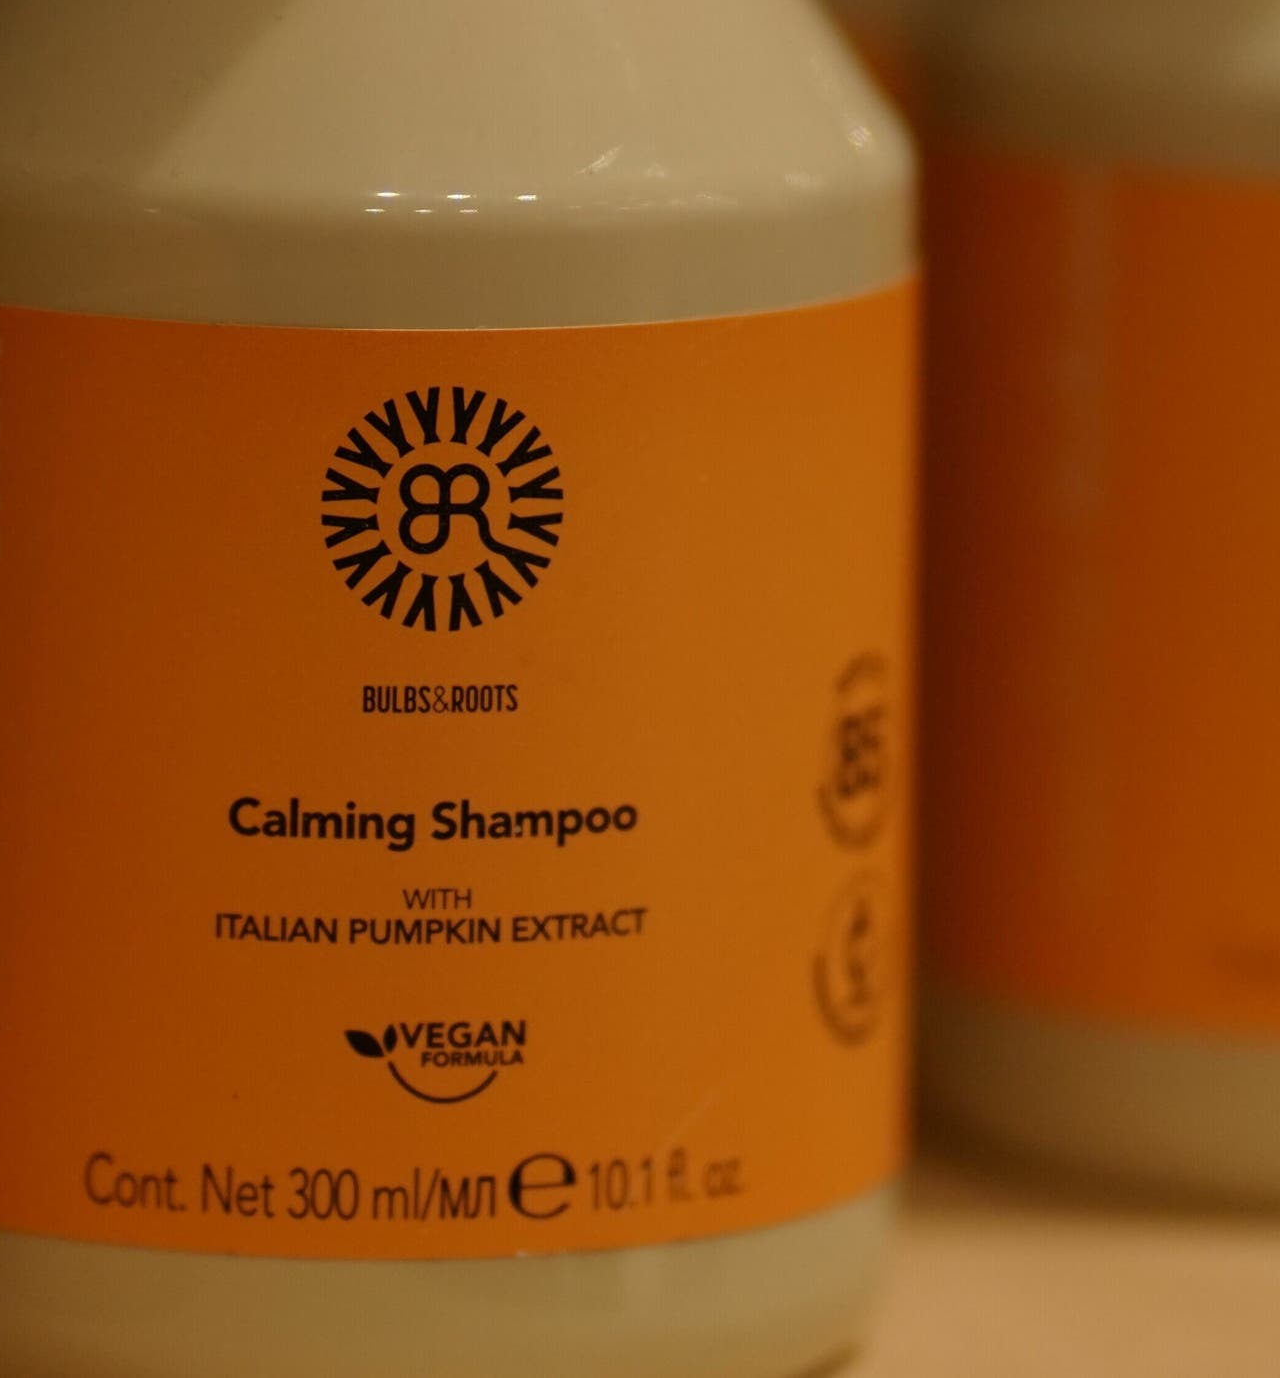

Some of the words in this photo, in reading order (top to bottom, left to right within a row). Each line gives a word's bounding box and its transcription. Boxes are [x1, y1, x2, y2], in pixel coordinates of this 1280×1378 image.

[362, 684, 519, 714] BULBS&ROOTS
[228, 796, 417, 853] Calming
[431, 798, 639, 849] Shampoo
[402, 888, 473, 911] WITH
[214, 911, 339, 946] ITALIAN
[347, 916, 503, 947] PUMPKIN
[511, 907, 648, 944] EXTRACT
[399, 1020, 527, 1050] VEGAN
[420, 1049, 524, 1068] FORMULA
[83, 1150, 188, 1213] Cont.
[200, 1163, 276, 1220] Net
[287, 1166, 361, 1222] 300
